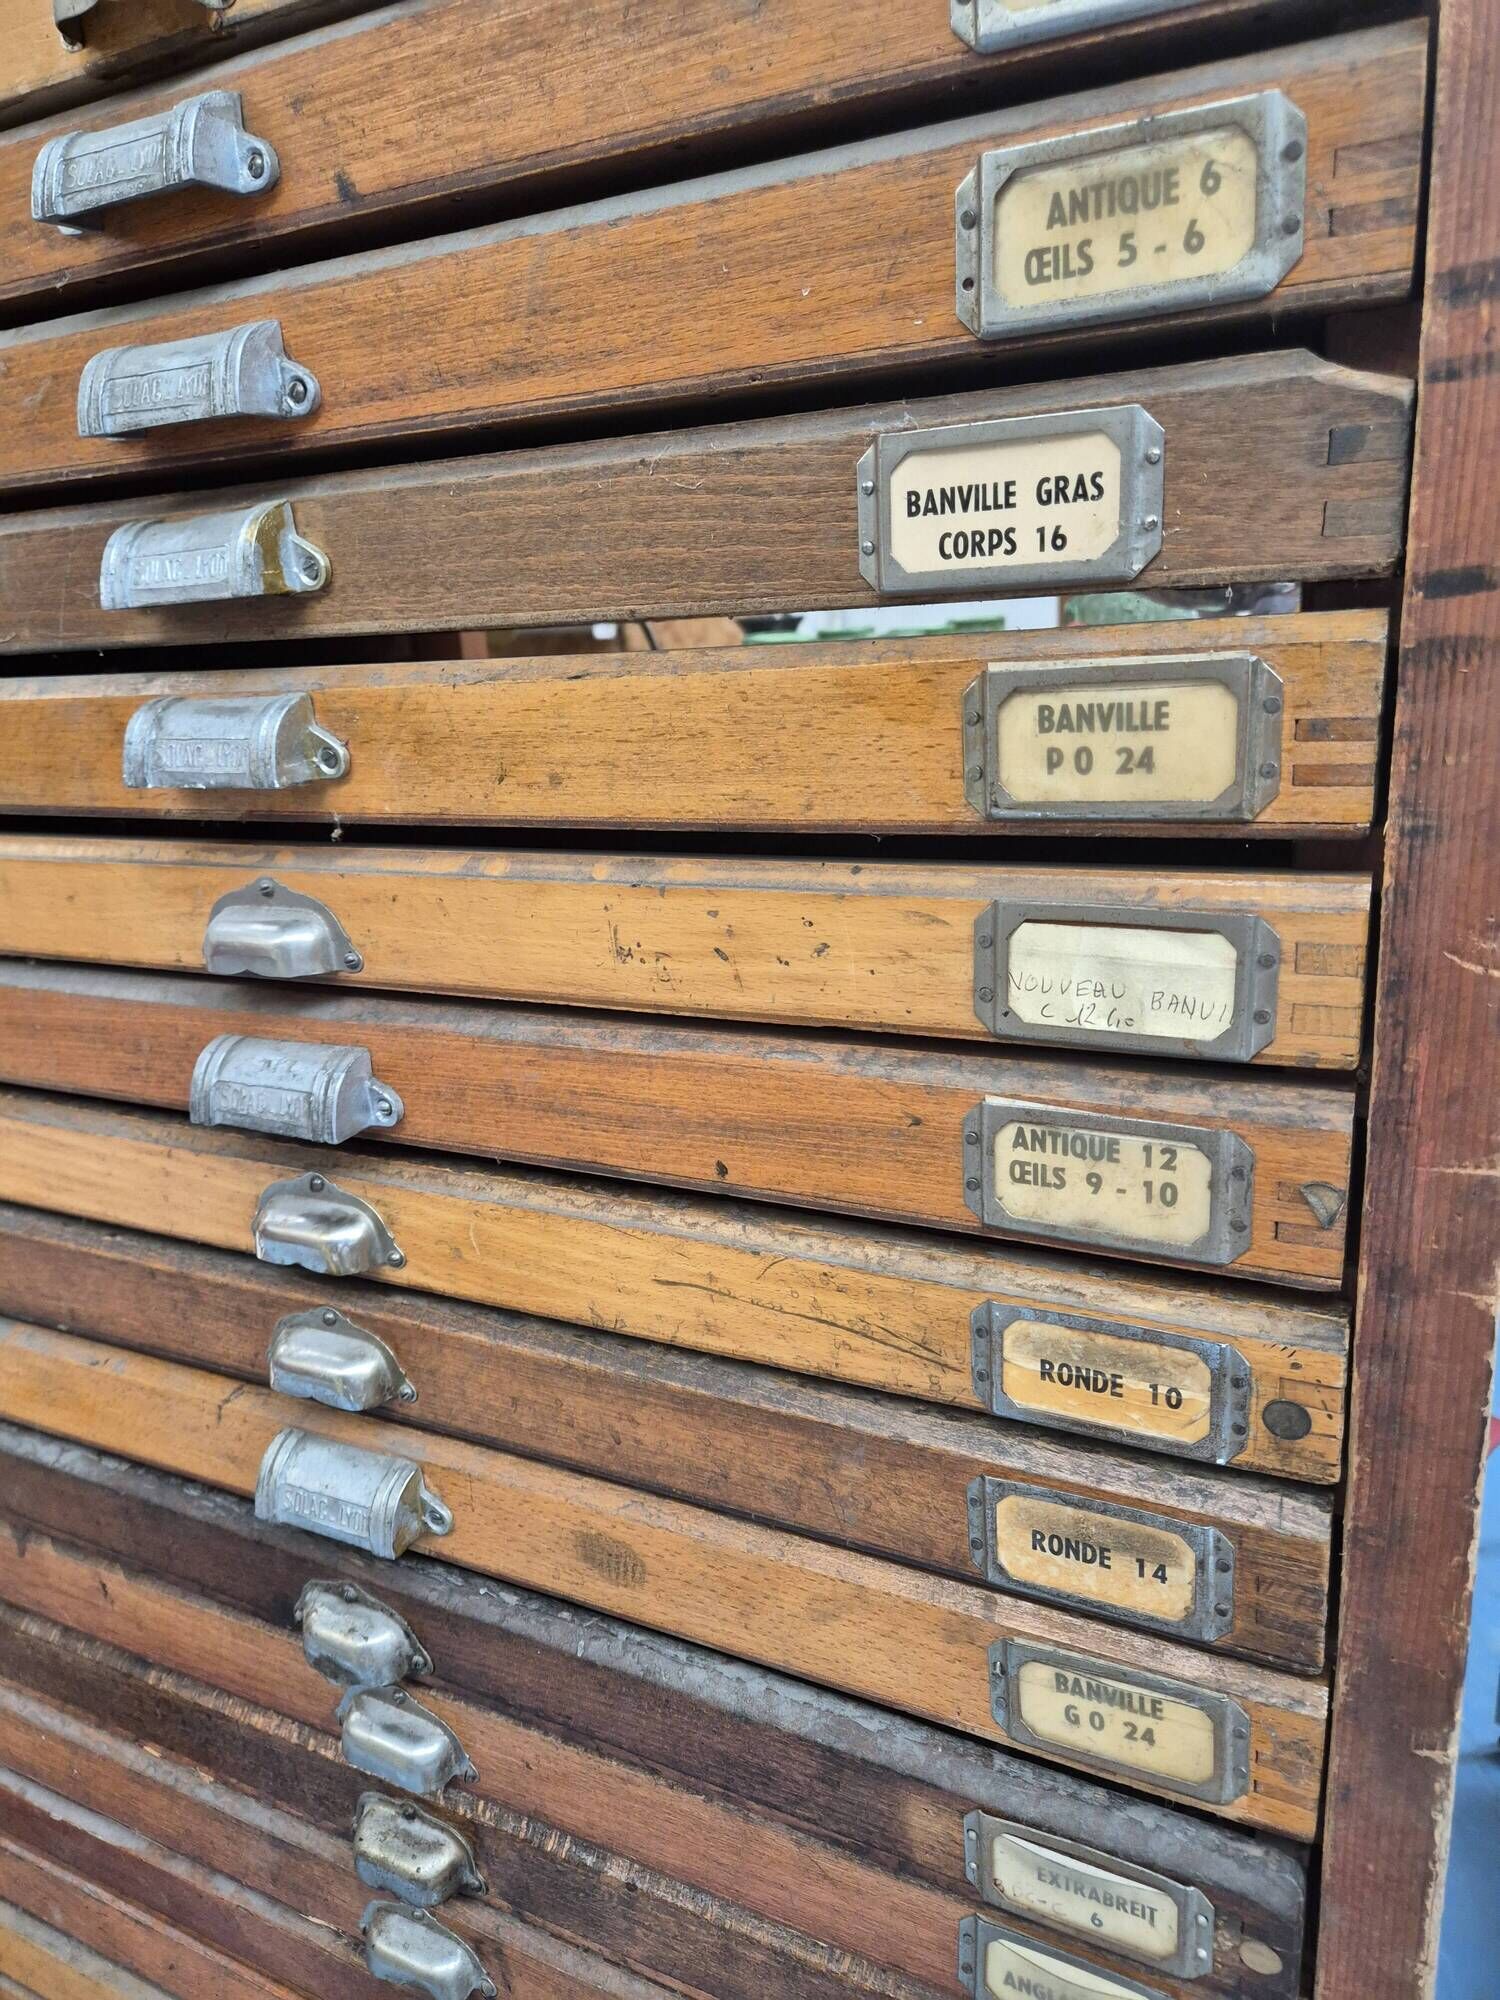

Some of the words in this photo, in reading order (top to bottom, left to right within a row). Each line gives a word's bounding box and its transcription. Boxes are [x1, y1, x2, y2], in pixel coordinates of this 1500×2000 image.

[1046, 167, 1179, 230] ANTIQUE
[1199, 160, 1222, 196] 6
[1024, 237, 1094, 285] ŒILS
[1117, 229, 1137, 267] 5
[1182, 219, 1205, 255] 6
[906, 479, 1016, 518] BANVILLE
[1036, 472, 1104, 504] GRAS
[938, 528, 1016, 560] CORPS
[1036, 525, 1067, 553] 16
[1037, 701, 1170, 734] BANVILLE
[1115, 746, 1155, 775] 24
[1008, 970, 1126, 1000] NOUVEAU
[1012, 1125, 1121, 1163] ANTIQUE
[1142, 1145, 1178, 1171] 12
[1009, 1162, 1066, 1190] ŒILS
[1086, 1170, 1103, 1195] 9
[1143, 1180, 1178, 1207] 10
[1040, 1359, 1123, 1398] RONDE
[1149, 1383, 1183, 1409] 10
[1032, 1529, 1111, 1570] RONDE
[1135, 1558, 1168, 1584] 14
[1054, 1672, 1163, 1721] BANVILLE
[1122, 1721, 1156, 1747] 24
[1037, 1866, 1158, 1928] EXTRABREIT
[1090, 1912, 1104, 1928] 6
